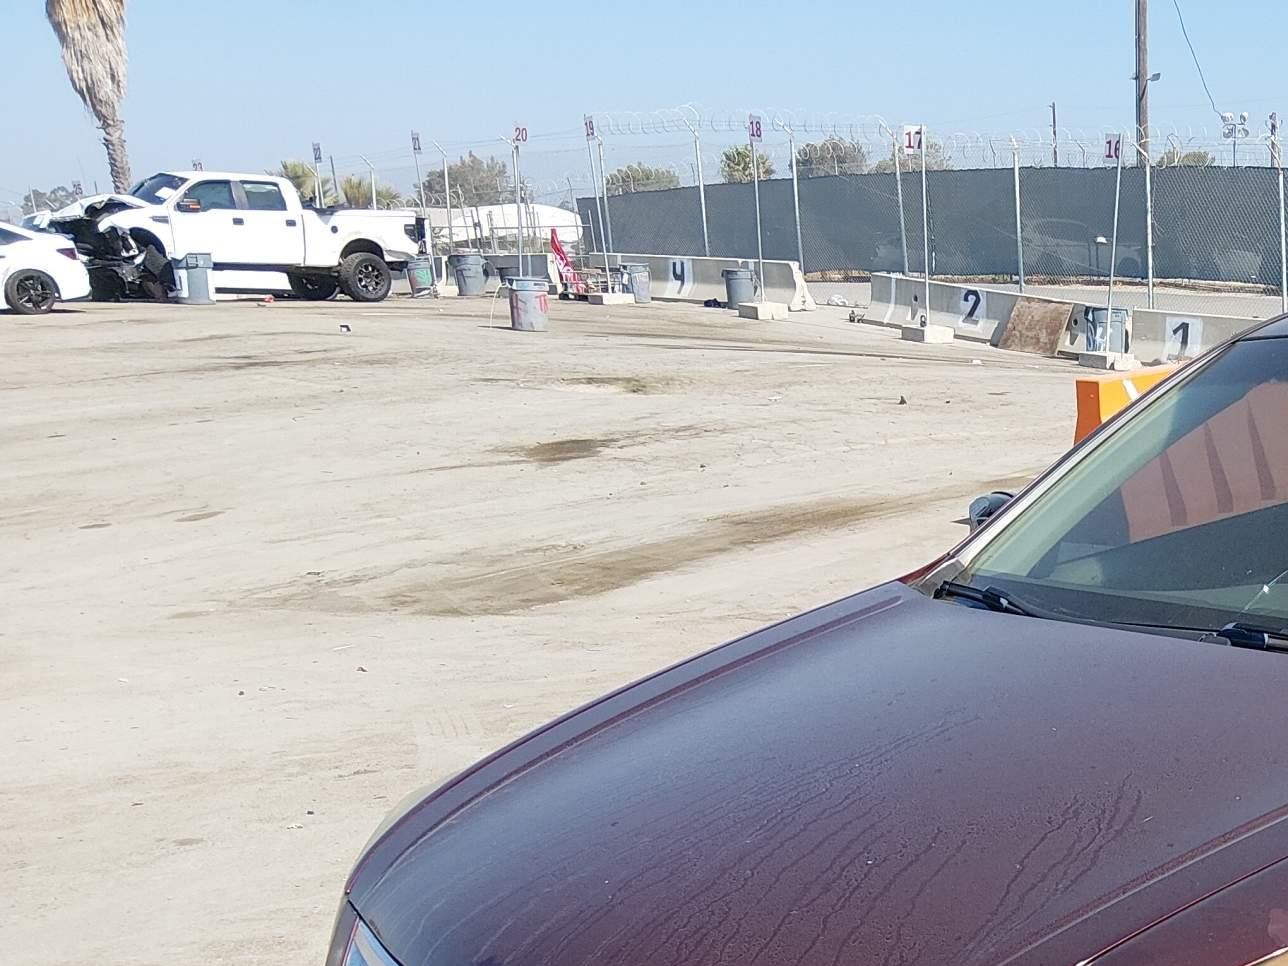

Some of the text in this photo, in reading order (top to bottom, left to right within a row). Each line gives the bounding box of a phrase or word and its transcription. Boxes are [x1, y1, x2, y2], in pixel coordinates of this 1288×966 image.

[515, 127, 528, 142] 20
[584, 120, 594, 136] 19
[750, 120, 761, 137] 18
[905, 131, 922, 149] 17
[672, 260, 685, 294] 4
[963, 290, 981, 325] 2
[1168, 322, 1191, 360] 1
